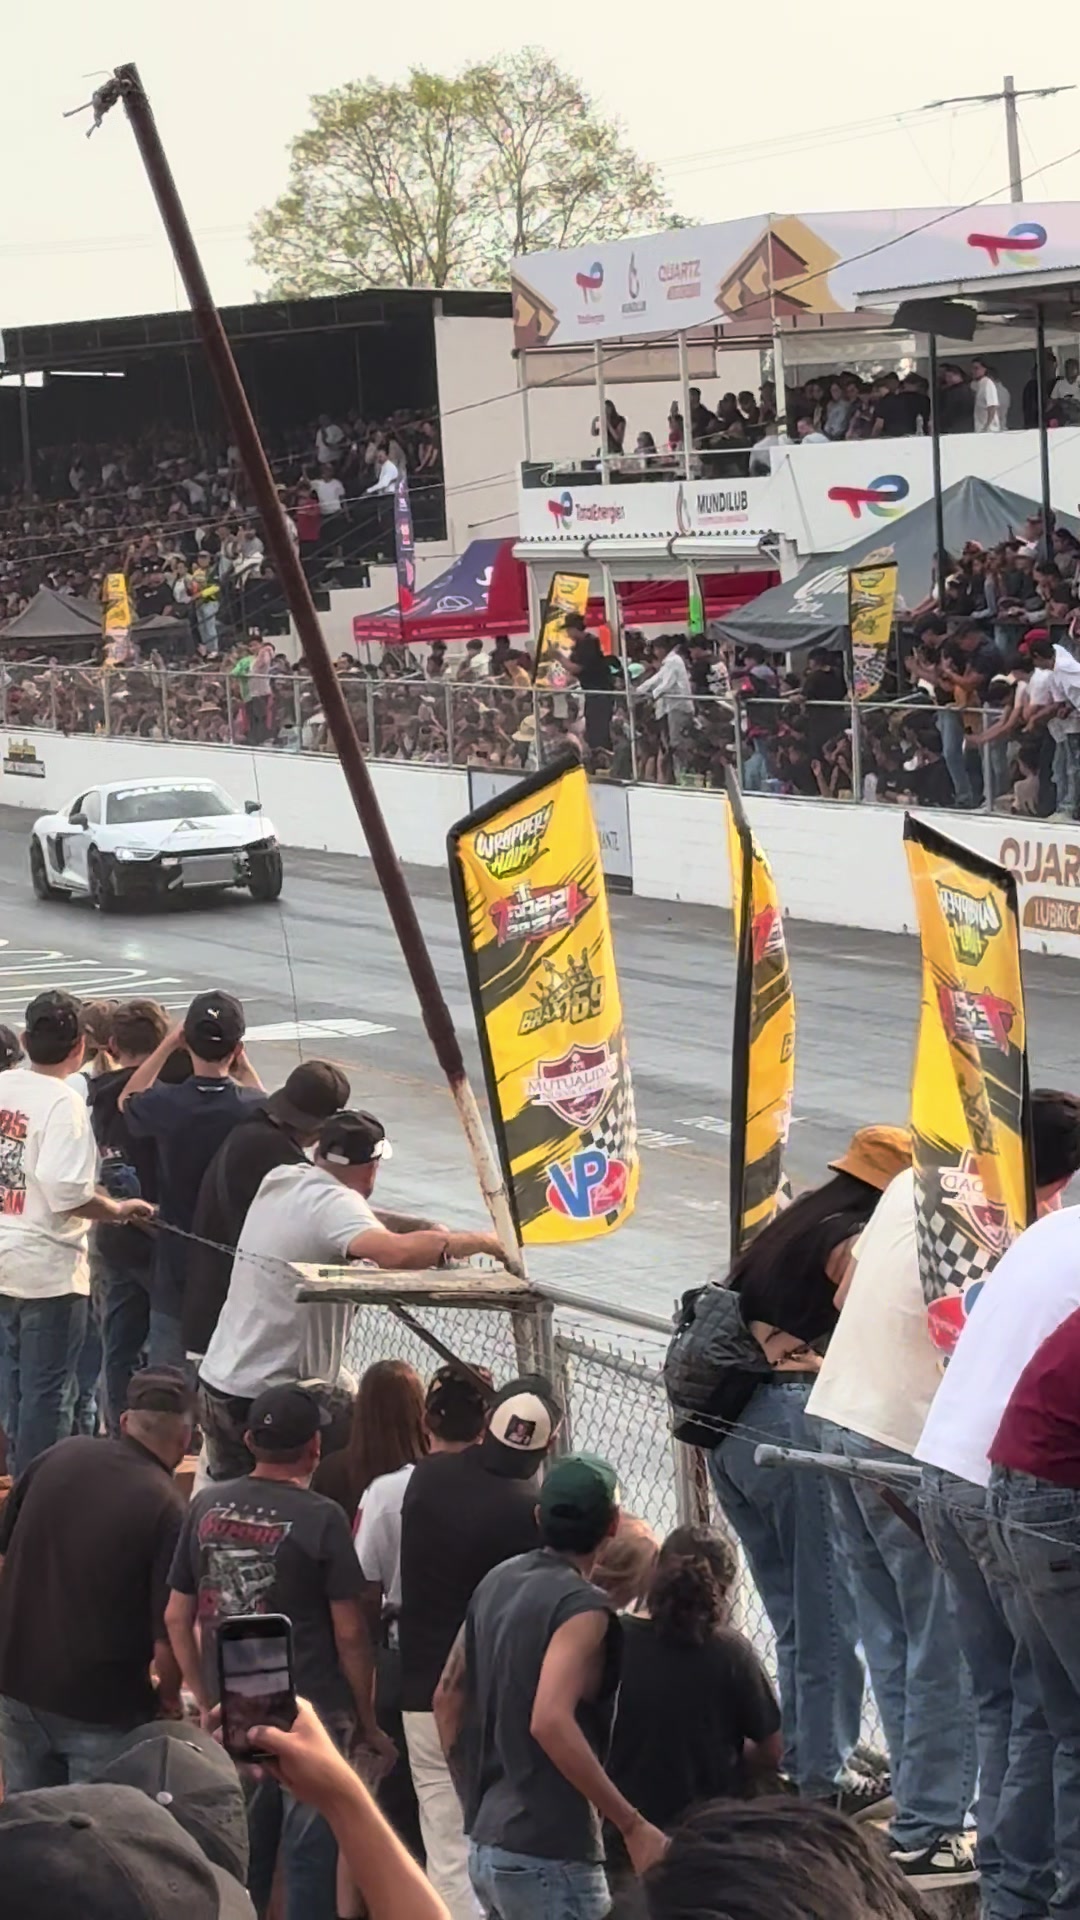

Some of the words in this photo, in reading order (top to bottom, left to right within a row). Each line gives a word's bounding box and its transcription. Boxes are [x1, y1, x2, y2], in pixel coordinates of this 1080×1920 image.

[658, 259, 701, 282] QUARTZ
[697, 490, 748, 514] MUNDILUB
[546, 1150, 608, 1218] VP
